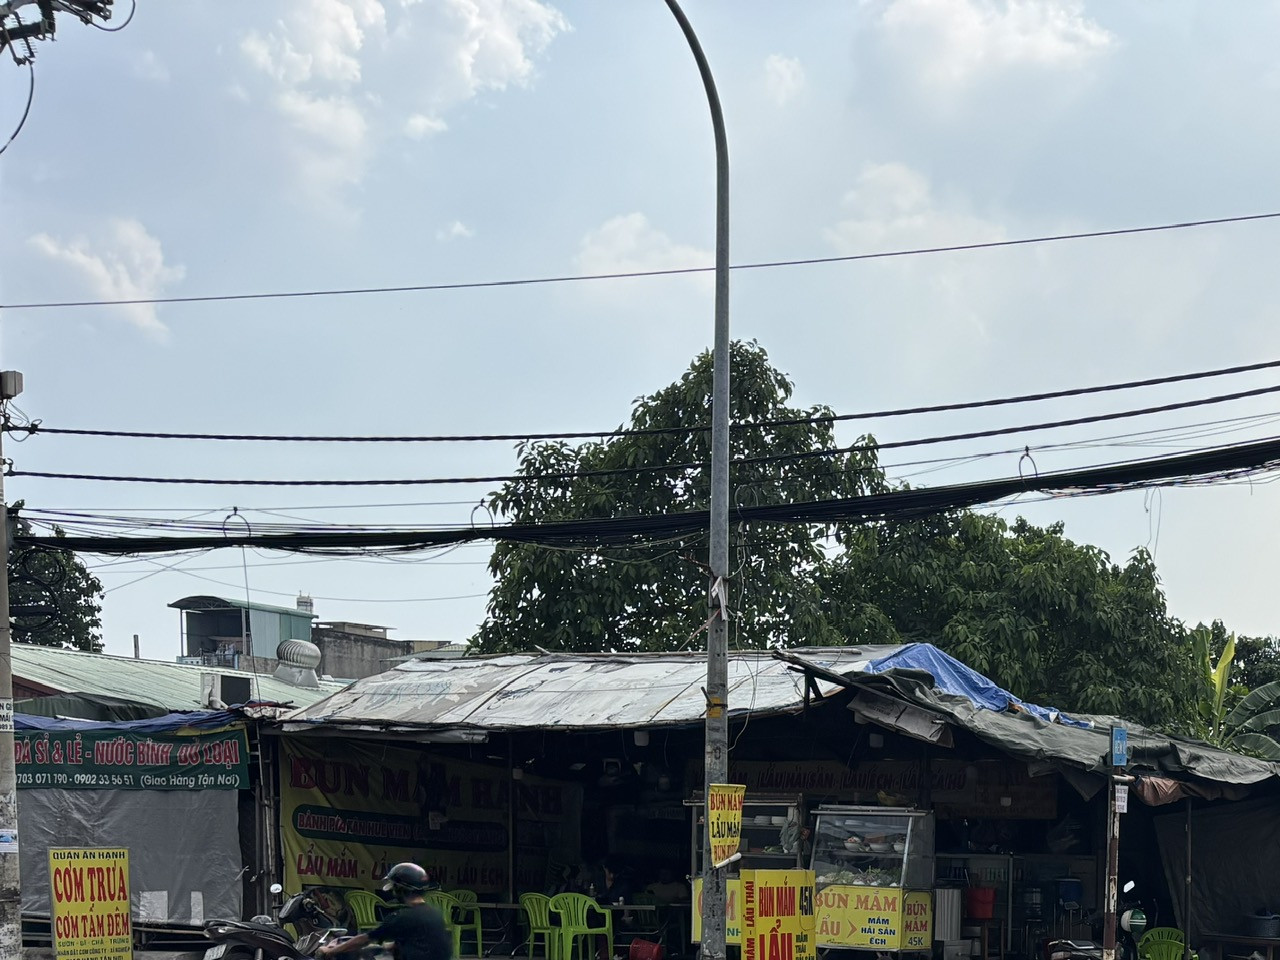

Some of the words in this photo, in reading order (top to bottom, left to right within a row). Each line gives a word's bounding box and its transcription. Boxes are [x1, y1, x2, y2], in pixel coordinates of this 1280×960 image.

[52, 741, 63, 764] &
[94, 736, 134, 765] NƯỚC
[137, 738, 173, 765] BÌNH
[203, 740, 240, 769] LOẠI
[16, 774, 33, 784] 703
[74, 774, 97, 784] 0902
[98, 775, 110, 785] 33
[140, 775, 167, 788] (Giao
[169, 774, 195, 787] Hàng
[197, 774, 214, 788] Tận
[217, 774, 240, 787] Nơi)
[53, 861, 85, 903] CƠM
[87, 860, 128, 902] TRƯA
[759, 881, 775, 917] BÚN
[776, 876, 796, 917] MẮM
[854, 890, 897, 912] MẮM
[906, 901, 927, 916] BÚN
[56, 911, 80, 939] CƠM
[107, 906, 130, 938] ĐÊM
[816, 915, 840, 936] ẨU
[908, 937, 924, 946] 45K
